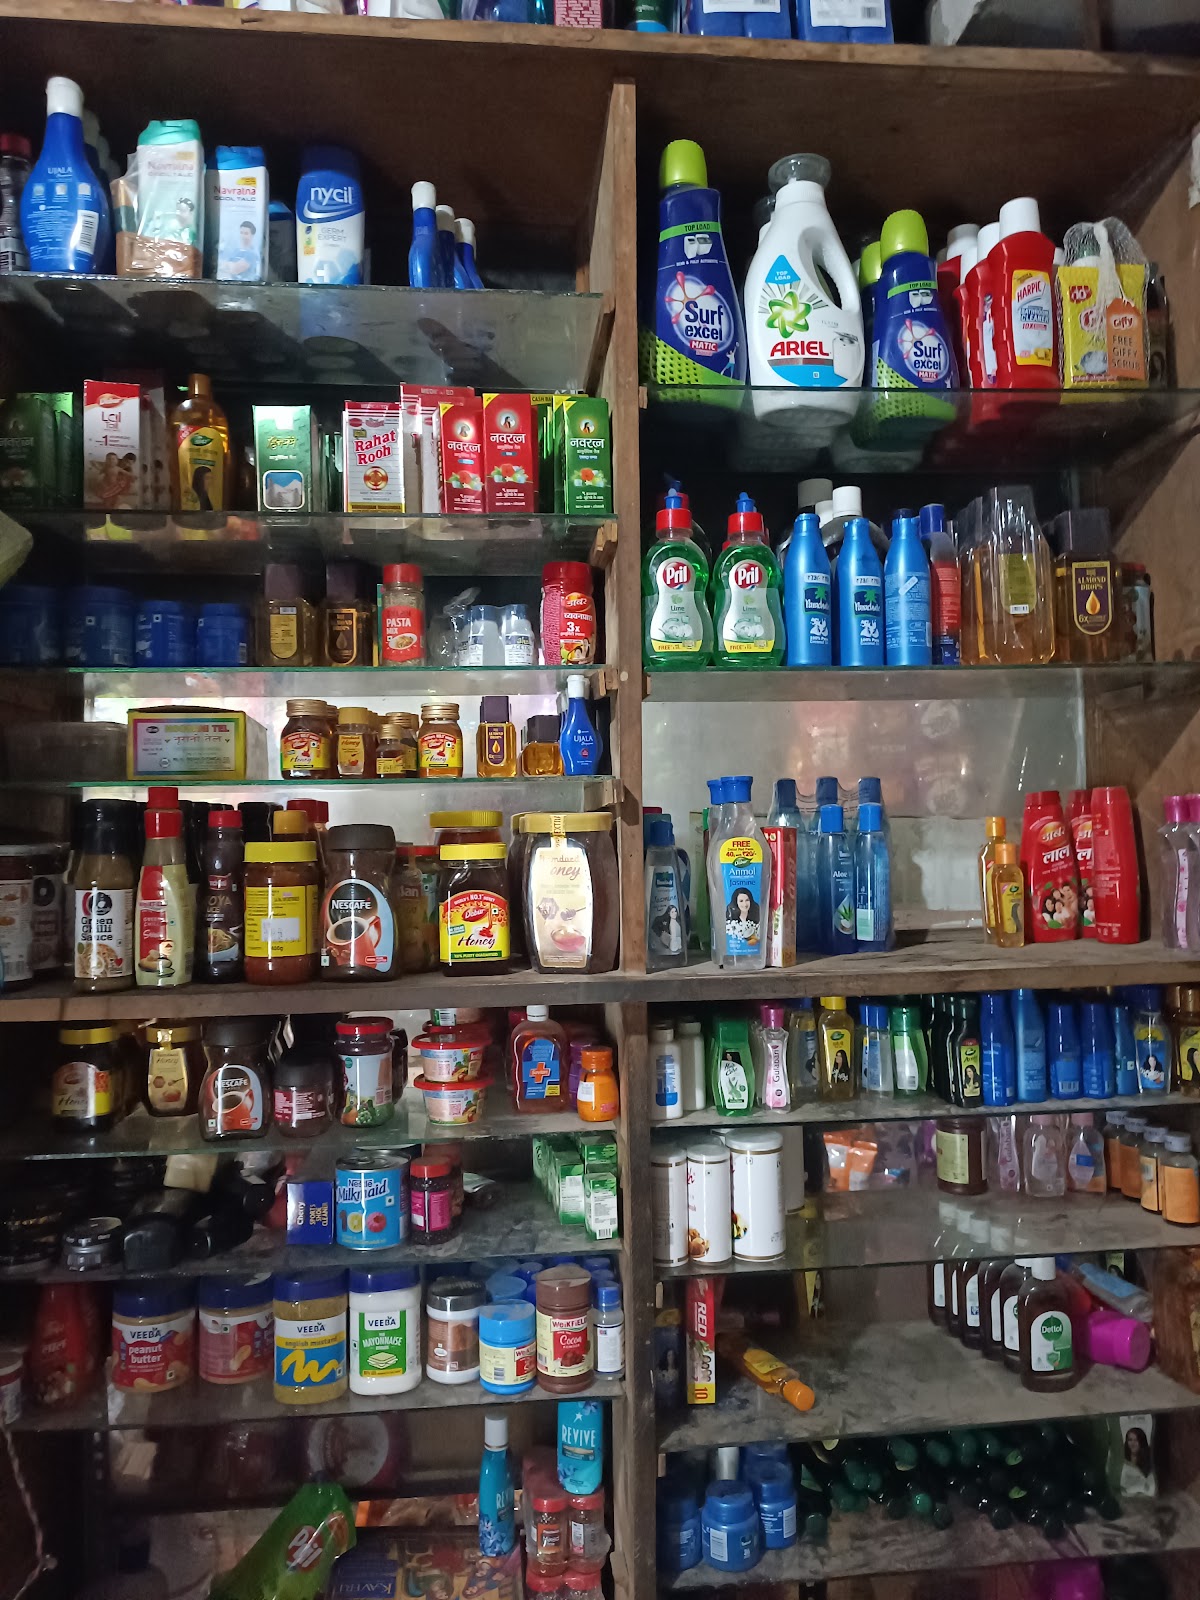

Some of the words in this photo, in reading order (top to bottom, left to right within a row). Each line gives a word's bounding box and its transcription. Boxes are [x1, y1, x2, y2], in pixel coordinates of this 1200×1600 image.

[213, 185, 256, 196] Navratna
[310, 186, 353, 206] nycil
[696, 223, 711, 231] LOAD
[318, 234, 347, 242] EXPERT
[1017, 281, 1042, 302] HARPIC
[685, 300, 724, 325] Surf
[685, 323, 723, 341] excel
[691, 341, 717, 350] MATIC
[1112, 335, 1133, 346] FREE
[770, 341, 829, 357] ARIEL
[913, 341, 942, 359] Surf
[1112, 348, 1138, 358] GIFFY
[913, 358, 942, 371] excel
[355, 430, 396, 452] Rahat
[490, 433, 526, 444] नवरत्न
[570, 438, 605, 448] नवरत्न
[447, 441, 481, 453] नवरत्न
[357, 445, 391, 465] Rooh
[666, 566, 687, 585] Pril
[738, 567, 759, 586] Pril
[1078, 576, 1106, 584] ALMOND
[386, 617, 411, 628] PASTA
[574, 735, 594, 743] UJALA
[426, 755, 447, 763] Honey
[1042, 844, 1070, 865] लाल
[729, 867, 756, 876] Anmol
[729, 879, 756, 888] Jasmine
[465, 909, 484, 918] Dabur
[458, 934, 496, 949] Honey
[368, 1316, 396, 1327] VEEBA
[697, 1301, 707, 1338] RED
[130, 1327, 162, 1339] VEEBA
[297, 1322, 325, 1333] VEEBA
[1042, 1324, 1063, 1333] Dettol
[362, 1336, 402, 1348] MAYONNAISE
[559, 1335, 582, 1346] Cocoa
[128, 1344, 163, 1355] peanut
[131, 1353, 162, 1364] butter
[561, 1424, 596, 1447] REVIVE
